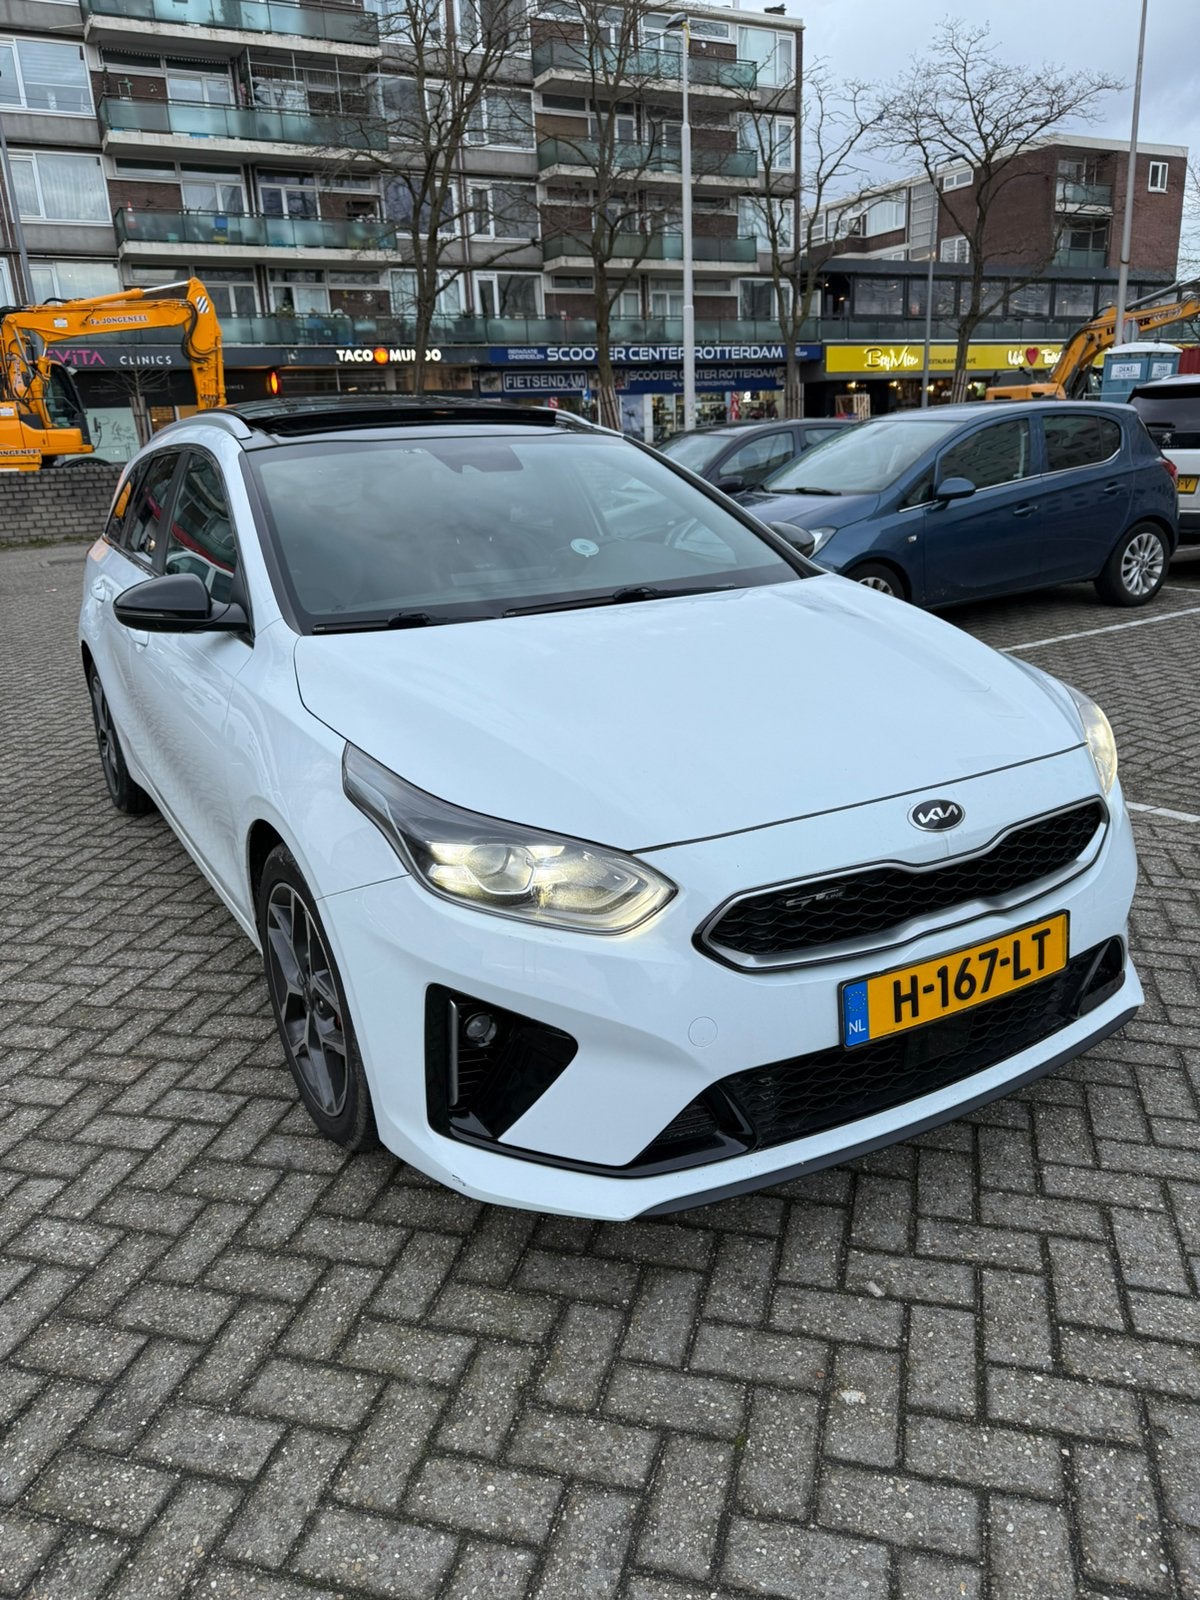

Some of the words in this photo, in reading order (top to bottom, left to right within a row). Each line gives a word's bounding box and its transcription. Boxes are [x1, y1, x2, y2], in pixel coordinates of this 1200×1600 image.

[102, 314, 148, 324] JONGENEEL
[119, 355, 172, 365] CLINICS
[336, 349, 374, 362] TACO
[546, 347, 627, 361] SCOOER
[693, 346, 784, 360] ROTTERDAM
[629, 370, 678, 381] SCOOTER
[680, 370, 717, 380] CNTER
[718, 368, 776, 379] ROTTERDAM
[0, 448, 41, 457] NGENEEL
[917, 804, 959, 824] KIA
[893, 928, 1051, 1024] H-167-LT
[849, 1019, 866, 1035] NL
